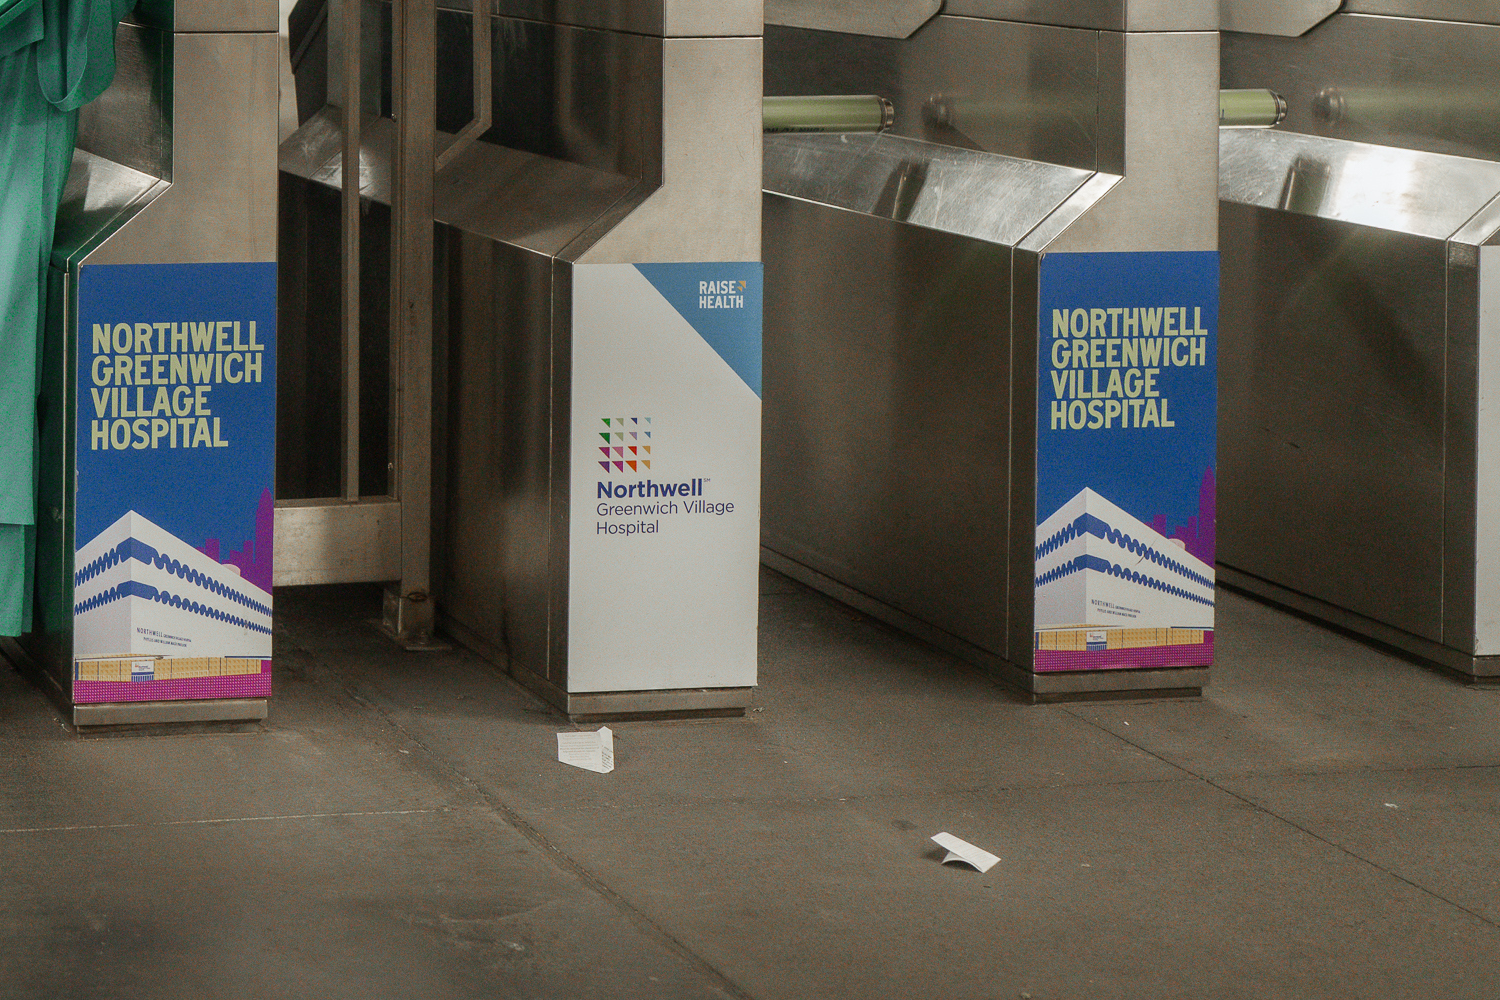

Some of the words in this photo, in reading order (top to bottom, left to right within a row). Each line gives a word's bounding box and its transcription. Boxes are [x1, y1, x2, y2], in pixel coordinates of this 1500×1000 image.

[699, 280, 737, 295] RAISE
[699, 295, 744, 309] HEALTH
[92, 321, 265, 354] NORTHWELL
[1052, 307, 1208, 338] NORTHWELL
[1051, 337, 1206, 369] GREENWICH
[91, 352, 262, 386] GREENWICH
[1050, 368, 1160, 399] VILLAGE
[90, 385, 212, 418] VILLAGE
[1051, 398, 1175, 430] HOSPITAL
[91, 417, 229, 450] HOSPITAL
[597, 478, 702, 498] Northwell
[596, 500, 678, 516] Greenwich
[683, 500, 735, 516] Village
[596, 520, 659, 537] Hospital
